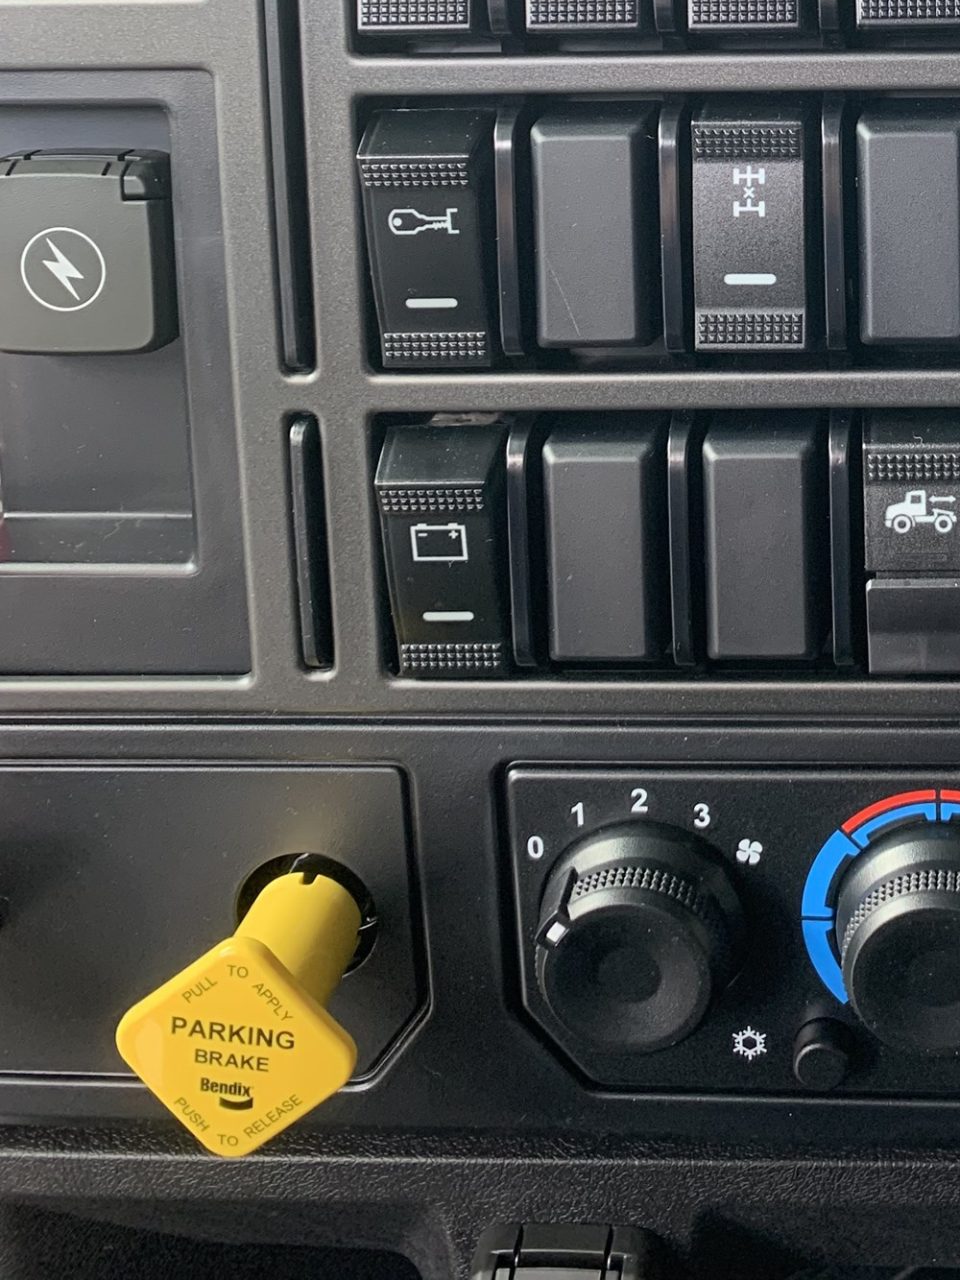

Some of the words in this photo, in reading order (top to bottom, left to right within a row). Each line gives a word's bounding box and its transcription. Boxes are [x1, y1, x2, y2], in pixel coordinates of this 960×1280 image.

[526, 835, 545, 860] 0
[570, 801, 585, 828] 1
[630, 787, 649, 814] 2
[693, 802, 712, 828] 3
[181, 976, 218, 1004] PULL
[226, 964, 249, 979] TO
[251, 982, 294, 1023] APPLY
[171, 1016, 296, 1050] PARKING
[194, 1048, 270, 1073] BRAKE
[199, 1077, 252, 1098] Bendix
[173, 1096, 211, 1133] PUSH
[216, 1133, 239, 1148] TO
[242, 1093, 304, 1138] RELEASE
